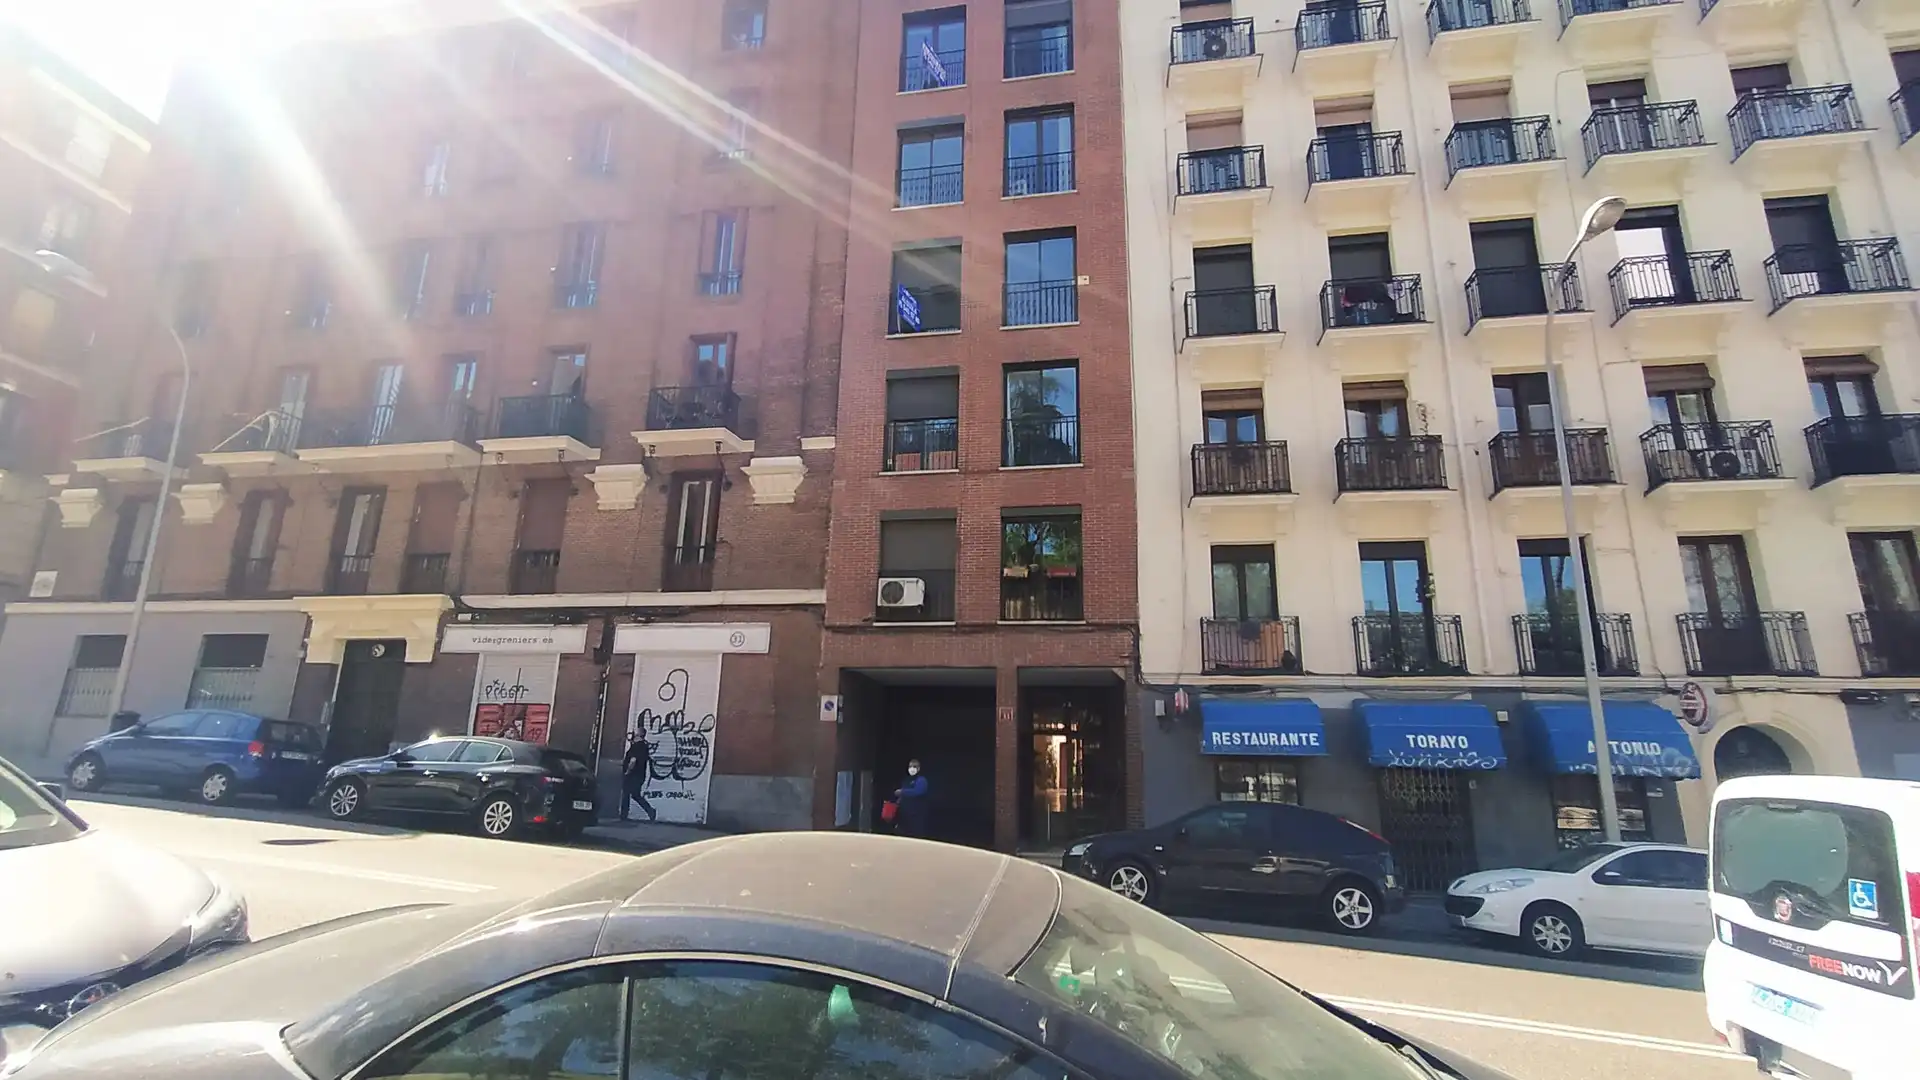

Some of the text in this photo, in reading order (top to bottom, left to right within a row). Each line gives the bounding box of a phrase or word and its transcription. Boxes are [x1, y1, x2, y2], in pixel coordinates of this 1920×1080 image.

[1211, 731, 1320, 747] RESTAURANTE
[1405, 734, 1469, 749] TORAYO
[1587, 740, 1662, 756] ATONIO
